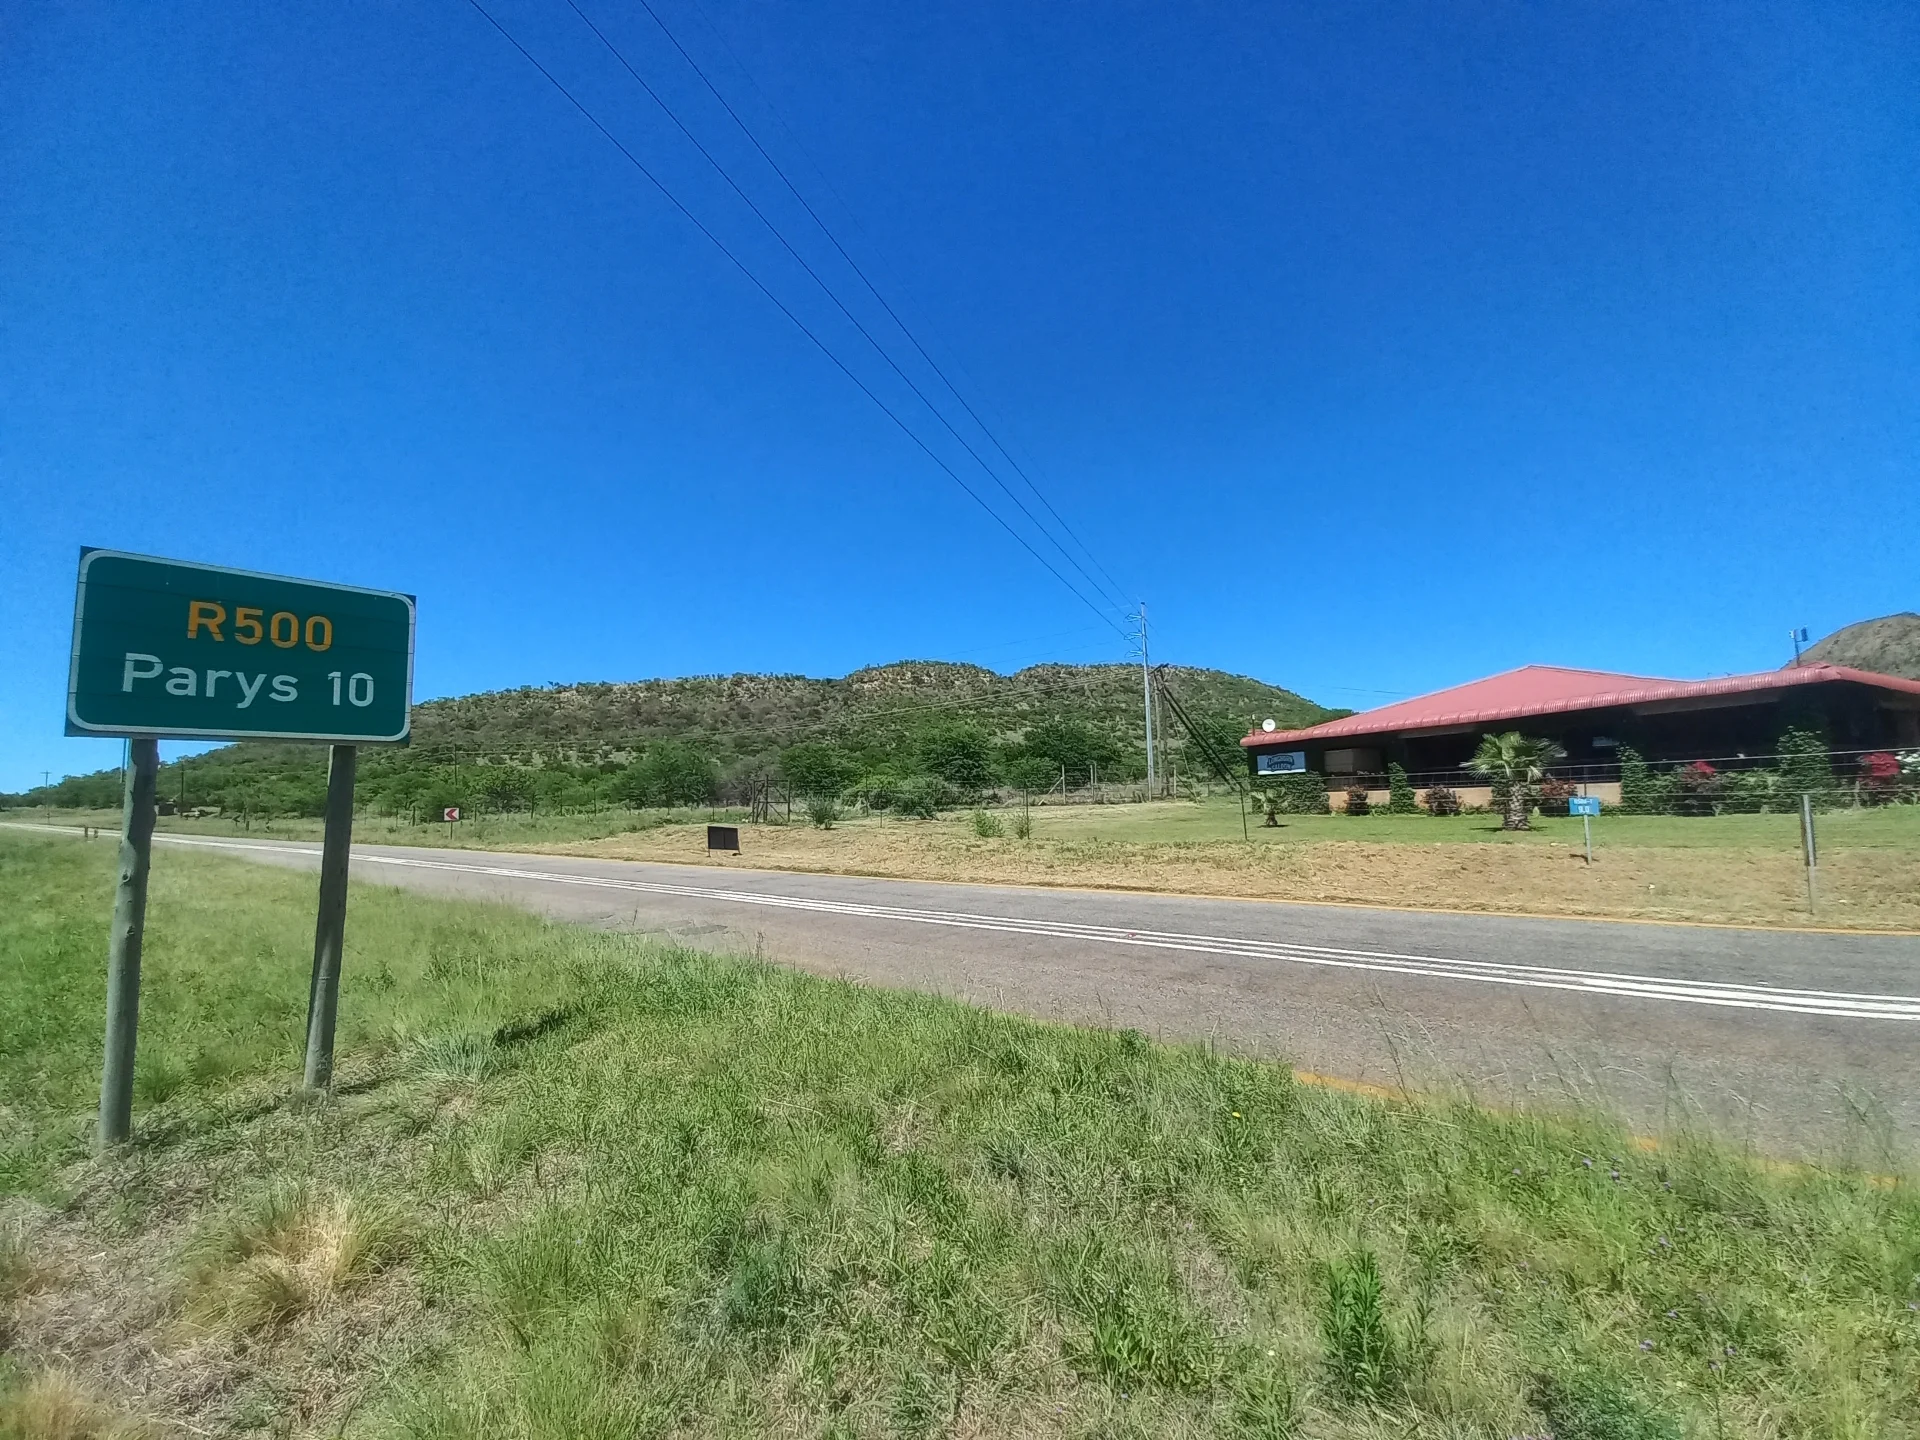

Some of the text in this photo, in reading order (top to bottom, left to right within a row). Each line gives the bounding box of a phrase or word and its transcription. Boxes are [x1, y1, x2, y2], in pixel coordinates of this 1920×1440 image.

[187, 600, 333, 651] R500
[122, 652, 375, 709] Parys 10
